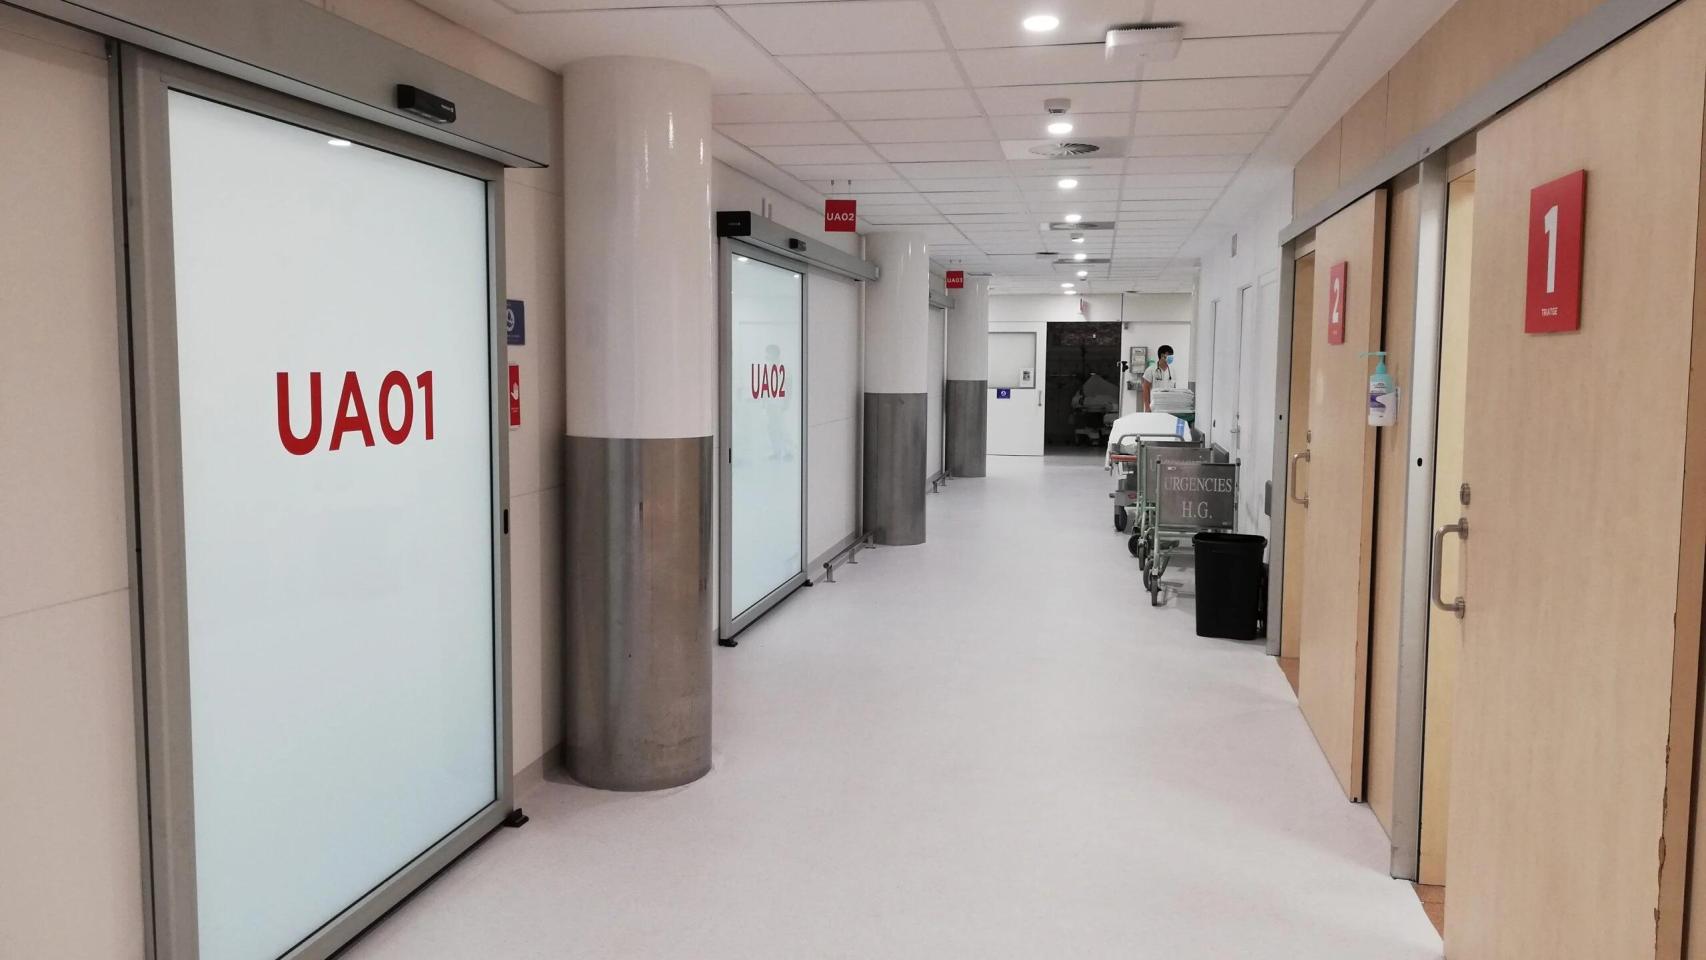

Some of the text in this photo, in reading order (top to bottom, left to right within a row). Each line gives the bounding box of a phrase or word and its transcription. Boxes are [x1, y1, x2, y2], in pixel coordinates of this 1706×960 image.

[826, 213, 855, 221] UA02
[1544, 204, 1559, 294] 1
[1332, 277, 1340, 324] 2
[751, 363, 786, 399] UA02
[276, 370, 434, 456] UA01
[1163, 477, 1233, 493] URGENCIES
[1182, 501, 1213, 519] H.G.
